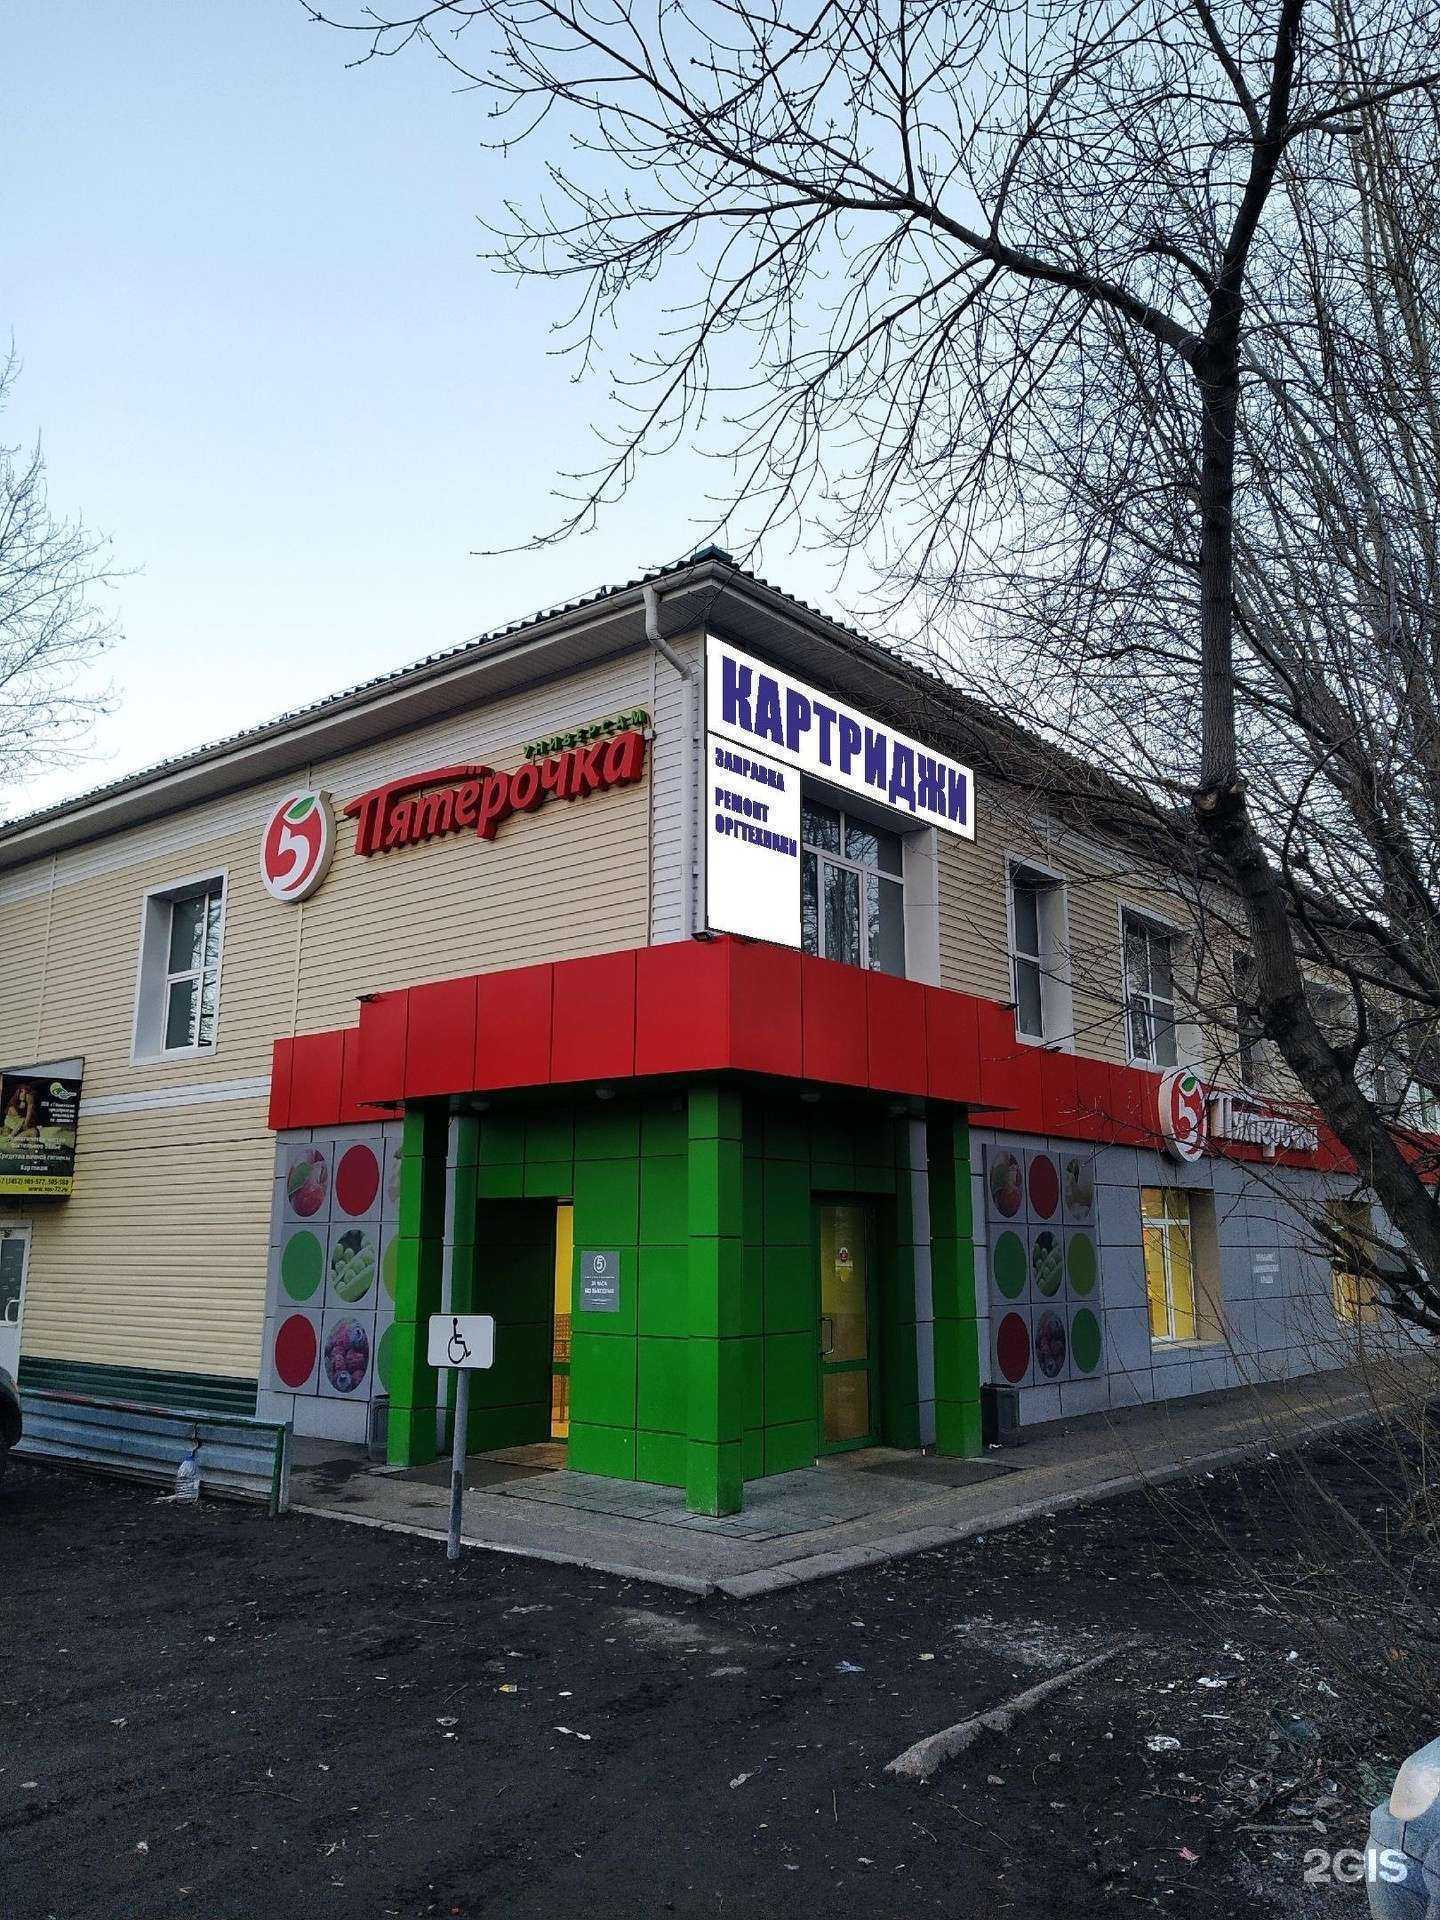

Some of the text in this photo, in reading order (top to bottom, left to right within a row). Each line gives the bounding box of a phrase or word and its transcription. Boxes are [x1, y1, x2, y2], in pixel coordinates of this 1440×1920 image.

[722, 655, 967, 826] КАРТРИДЖИ
[715, 747, 785, 792] ЗАПРАВКА
[715, 787, 769, 822] РЕМОНТ
[715, 814, 797, 858] ОРГТЕХНИКИ
